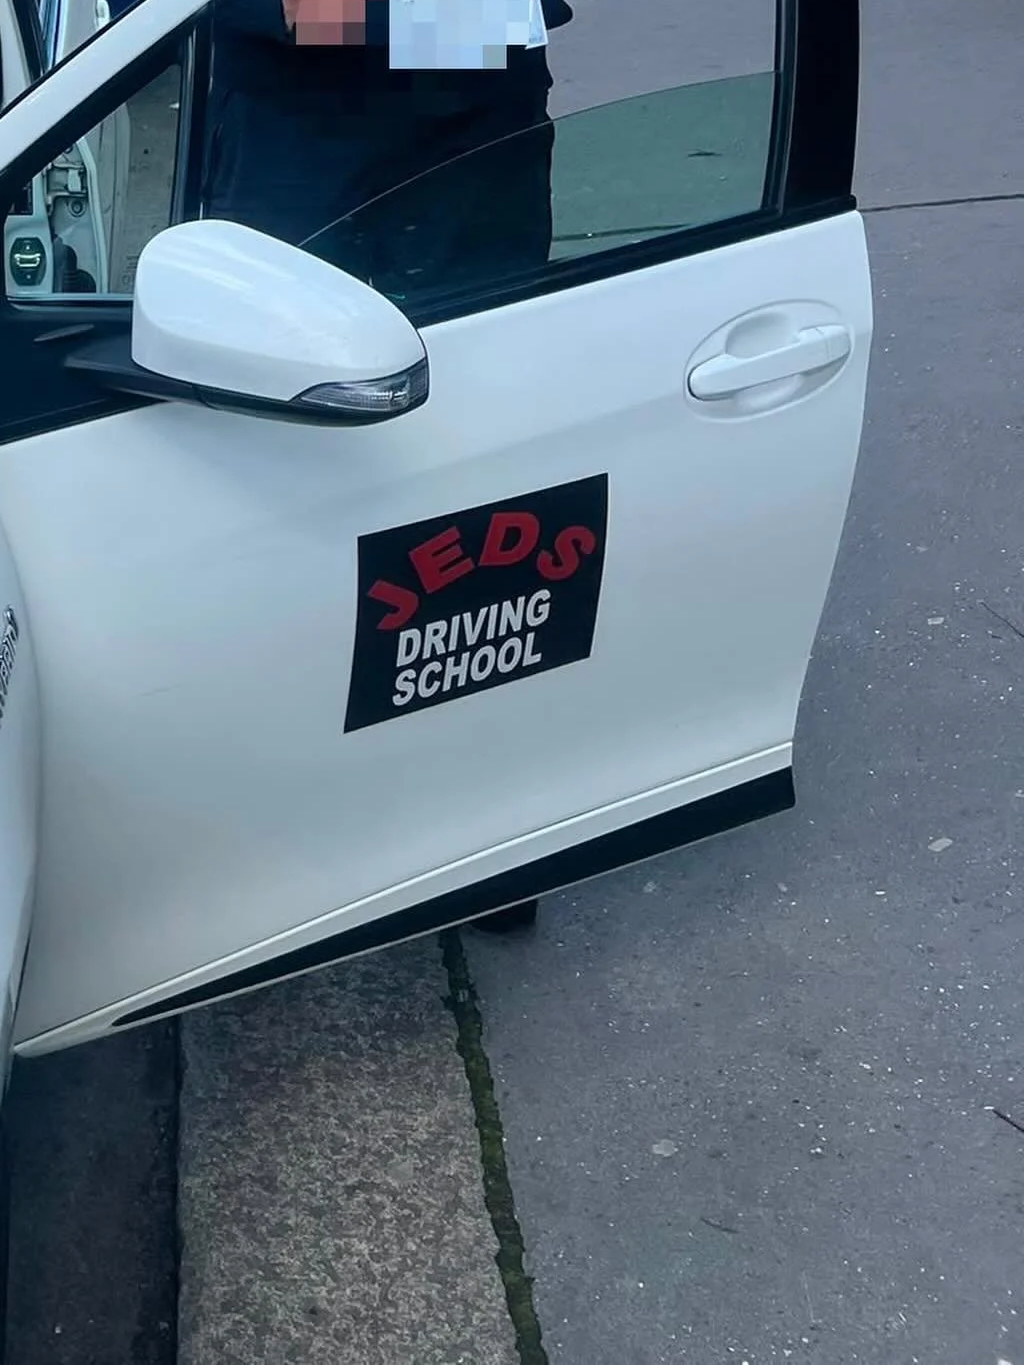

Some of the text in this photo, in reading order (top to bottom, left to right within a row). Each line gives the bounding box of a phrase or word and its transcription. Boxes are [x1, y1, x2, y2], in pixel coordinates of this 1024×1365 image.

[366, 511, 597, 631] JEDS
[396, 589, 552, 668] DRIVING
[392, 632, 543, 707] SCHOOL
